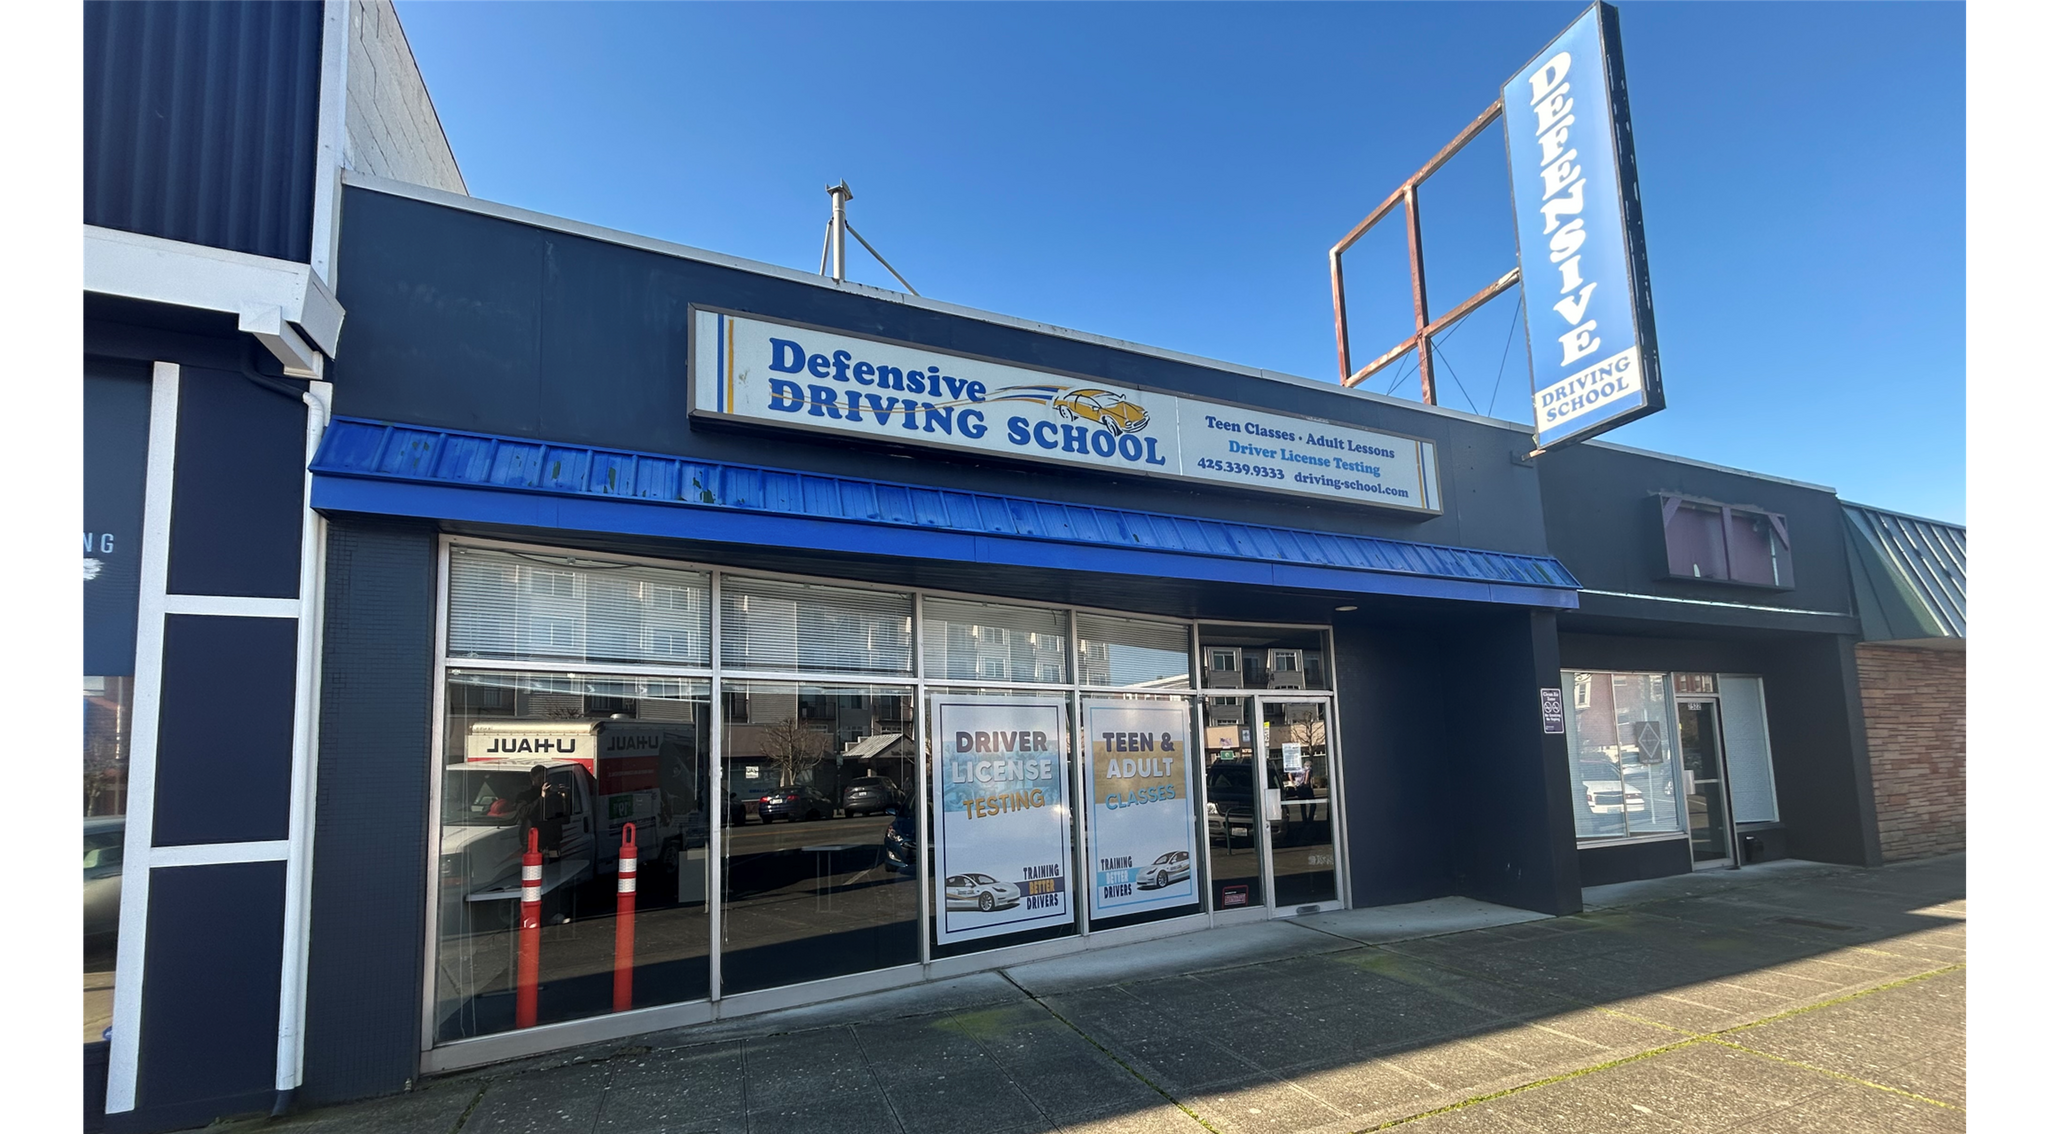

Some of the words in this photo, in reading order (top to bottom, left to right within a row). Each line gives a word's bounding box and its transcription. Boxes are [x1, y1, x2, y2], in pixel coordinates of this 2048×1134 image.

[1528, 51, 1601, 368] DEFENSIVE
[768, 337, 986, 403] Defensive
[1541, 356, 1631, 408] DRIVING
[1546, 378, 1629, 423] SCHOOL
[768, 378, 987, 440] DRIVING
[1007, 416, 1166, 466] SCHOOL
[1205, 415, 1242, 433] Teen
[1245, 422, 1296, 442] Classes
[1306, 433, 1345, 450] Adult
[1348, 440, 1395, 459] Lessons
[1229, 440, 1278, 459] Driver
[1280, 448, 1331, 468] License
[1333, 457, 1381, 478] Testing
[1197, 457, 1285, 480] 425.339.9333
[1294, 472, 1409, 499] driving-school.com
[955, 731, 1048, 753] DRIVER
[1102, 732, 1154, 753] TEEN
[1160, 732, 1175, 752] &
[951, 760, 1053, 784] LICENSE
[1106, 757, 1174, 779] ADULT
[963, 788, 1046, 820] TESTING
[1105, 784, 1176, 811] CLASSES
[1023, 864, 1060, 880] TRAINING
[1100, 856, 1133, 871] TRAINING
[1028, 880, 1055, 894] BETTER
[1105, 871, 1129, 884] BETTER
[1026, 894, 1059, 911] DRIVERS
[1103, 883, 1132, 899] DRIVERS
